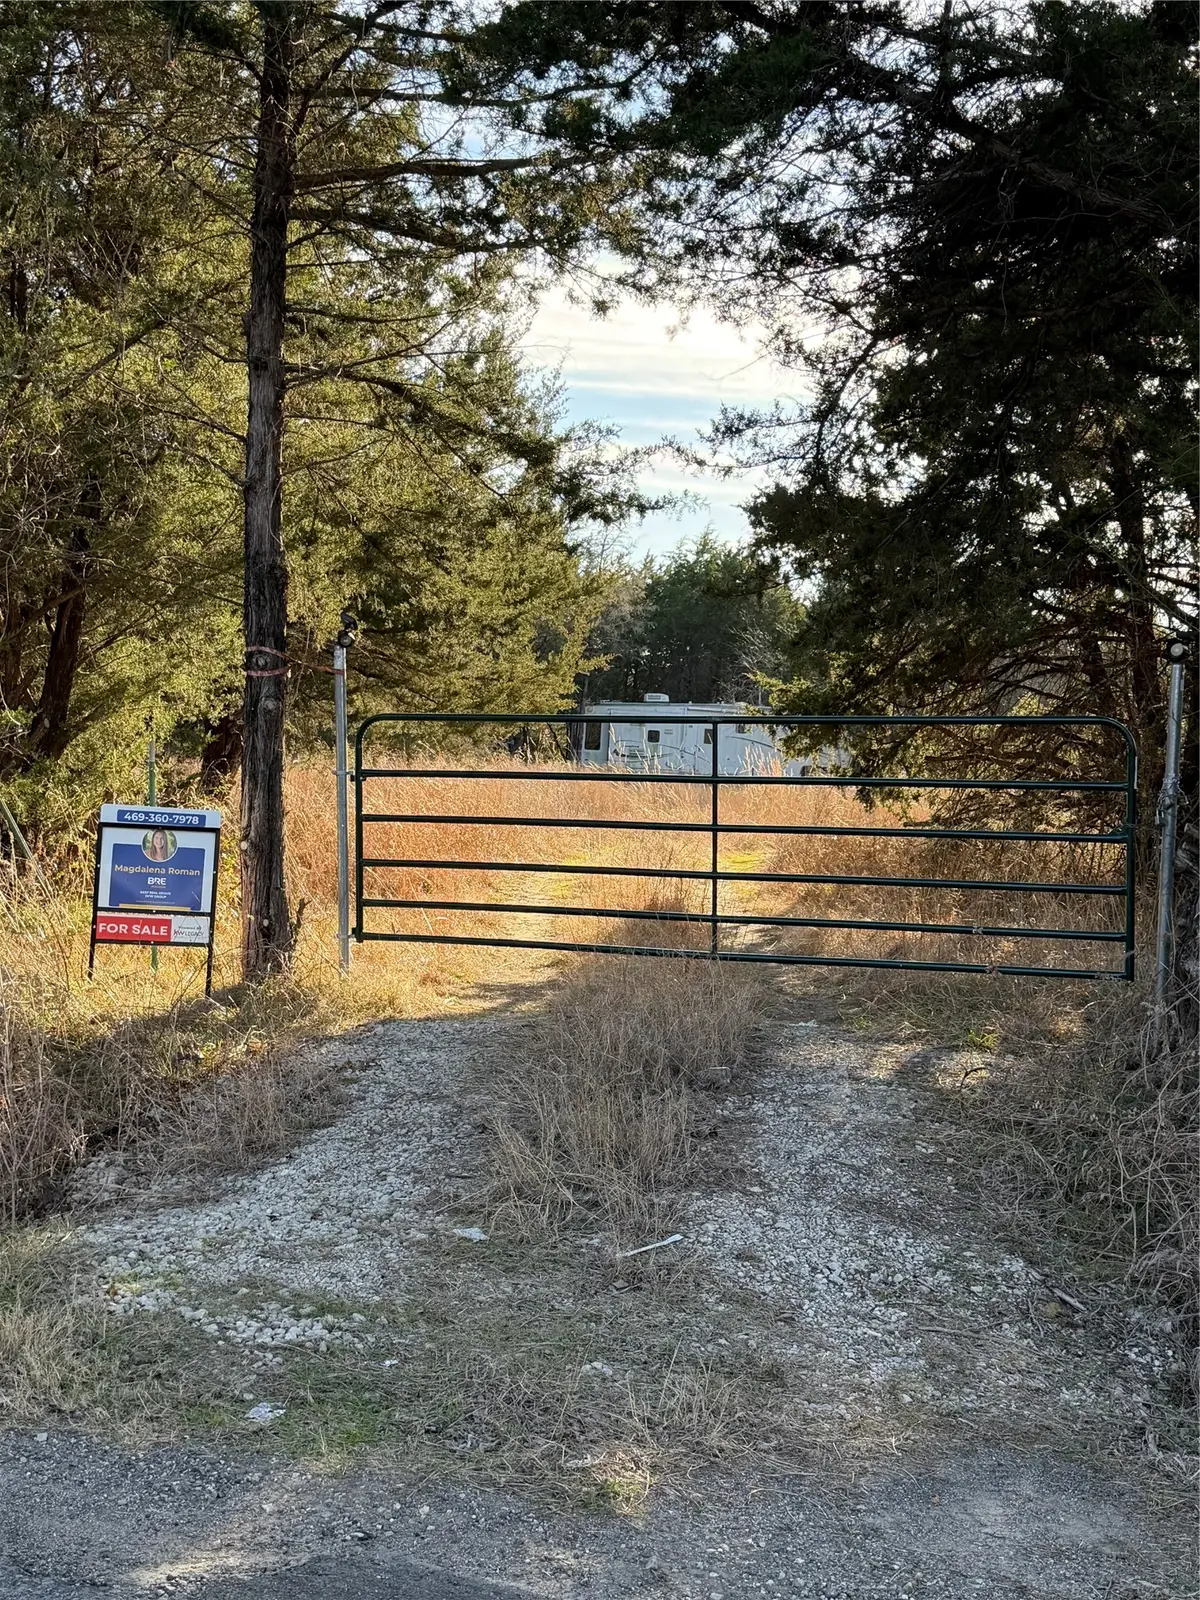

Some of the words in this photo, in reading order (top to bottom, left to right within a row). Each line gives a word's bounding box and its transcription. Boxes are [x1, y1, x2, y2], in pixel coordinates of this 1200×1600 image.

[124, 812, 199, 825] 469-360-7978
[114, 864, 166, 875] Magdalena
[168, 867, 200, 876] Roman
[147, 877, 167, 886] BRE
[98, 923, 128, 935] FOR
[131, 924, 168, 936] SALE
